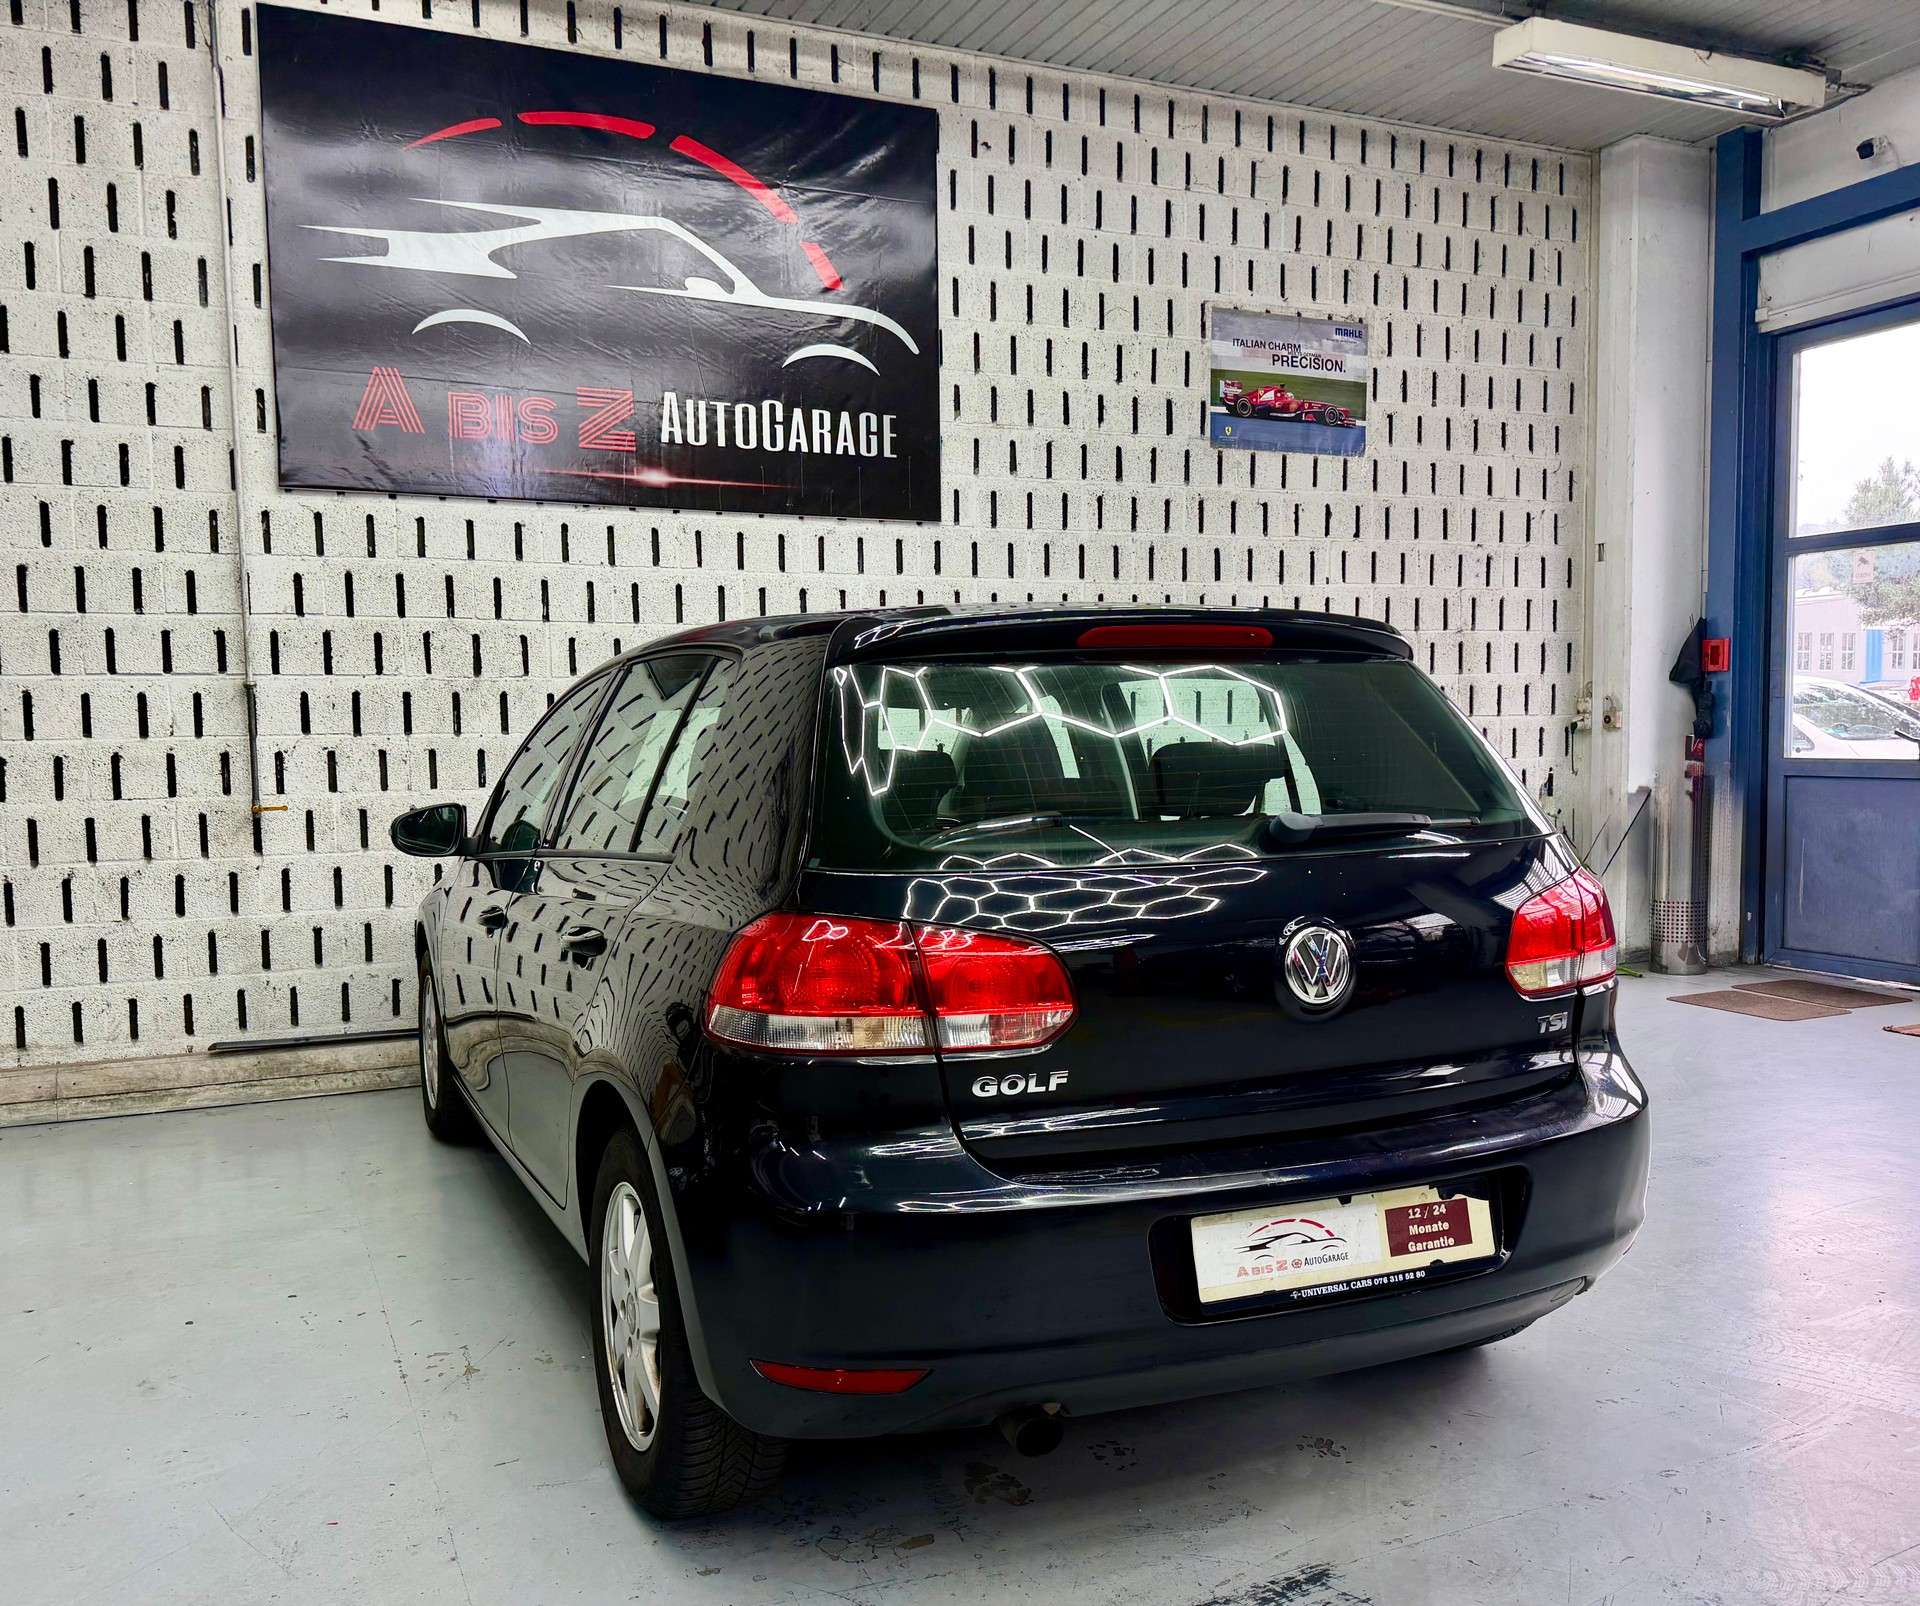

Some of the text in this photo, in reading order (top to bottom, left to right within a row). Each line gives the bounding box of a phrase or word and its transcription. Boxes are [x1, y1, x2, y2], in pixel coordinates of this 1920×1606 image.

[1334, 327, 1363, 339] MAHLE
[1232, 338, 1302, 353] ITALIAN CHARM
[1271, 353, 1346, 374] PRECISION.
[351, 366, 426, 434] A
[447, 390, 559, 445] BIS
[576, 386, 637, 452] Z
[1537, 1011, 1568, 1034] TSI
[971, 1070, 1069, 1098] GOLF
[1408, 1207, 1422, 1219] 12
[1432, 1203, 1447, 1216] 24
[1409, 1220, 1450, 1236] Monate
[1408, 1235, 1455, 1252] Garantie
[1236, 1266, 1249, 1278] A
[1251, 1264, 1274, 1276] BIS
[1276, 1259, 1289, 1272] Z
[1301, 1282, 1350, 1298] UNIVERSAL
[1351, 1278, 1373, 1289] CARS
[1374, 1275, 1388, 1286] 076
